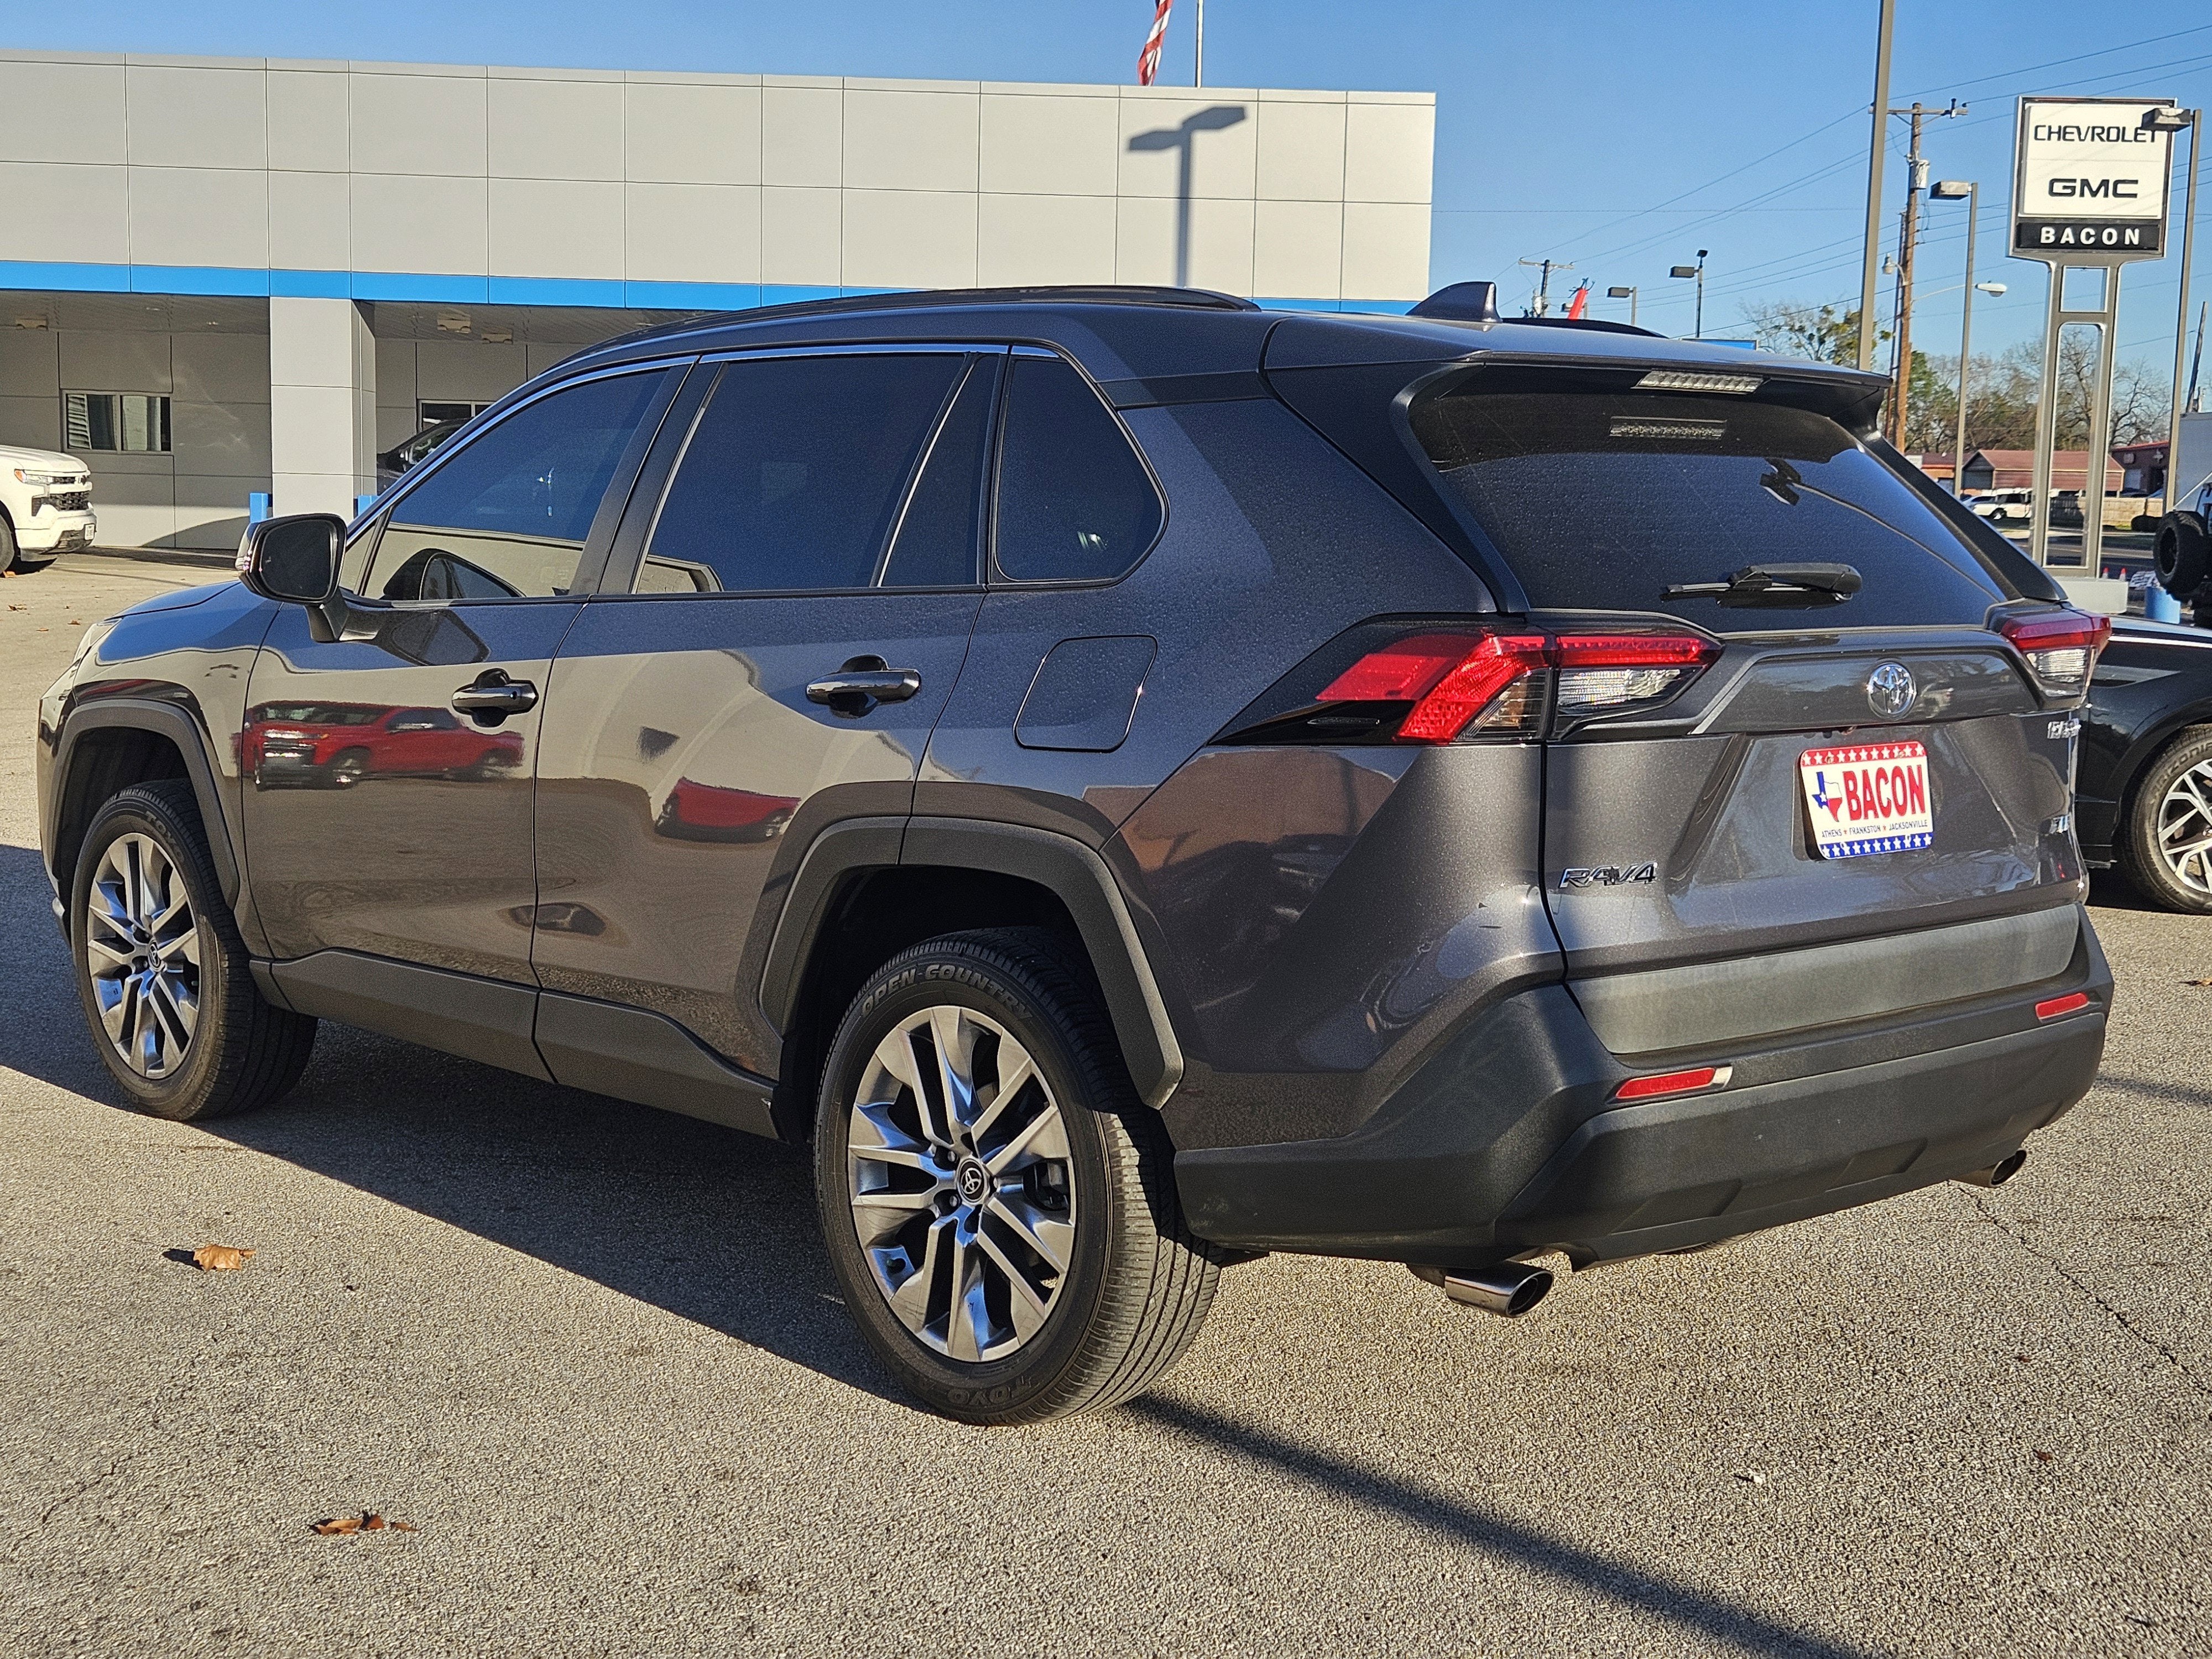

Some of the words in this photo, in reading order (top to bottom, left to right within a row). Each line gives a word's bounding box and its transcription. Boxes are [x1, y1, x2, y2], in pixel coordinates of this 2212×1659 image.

[2048, 178, 2139, 199] GMC
[2039, 226, 2140, 246] BACON
[1842, 764, 1926, 821] BACON
[144, 810, 185, 863] TOYO
[1822, 829, 1842, 838] ATHENS
[1849, 825, 1881, 835] FRANKSTON
[1889, 819, 1928, 831] JACKSONVILLE
[1558, 860, 1658, 889] RAV4
[861, 968, 916, 1018] OPEN
[924, 964, 1034, 1019] COUNTRY
